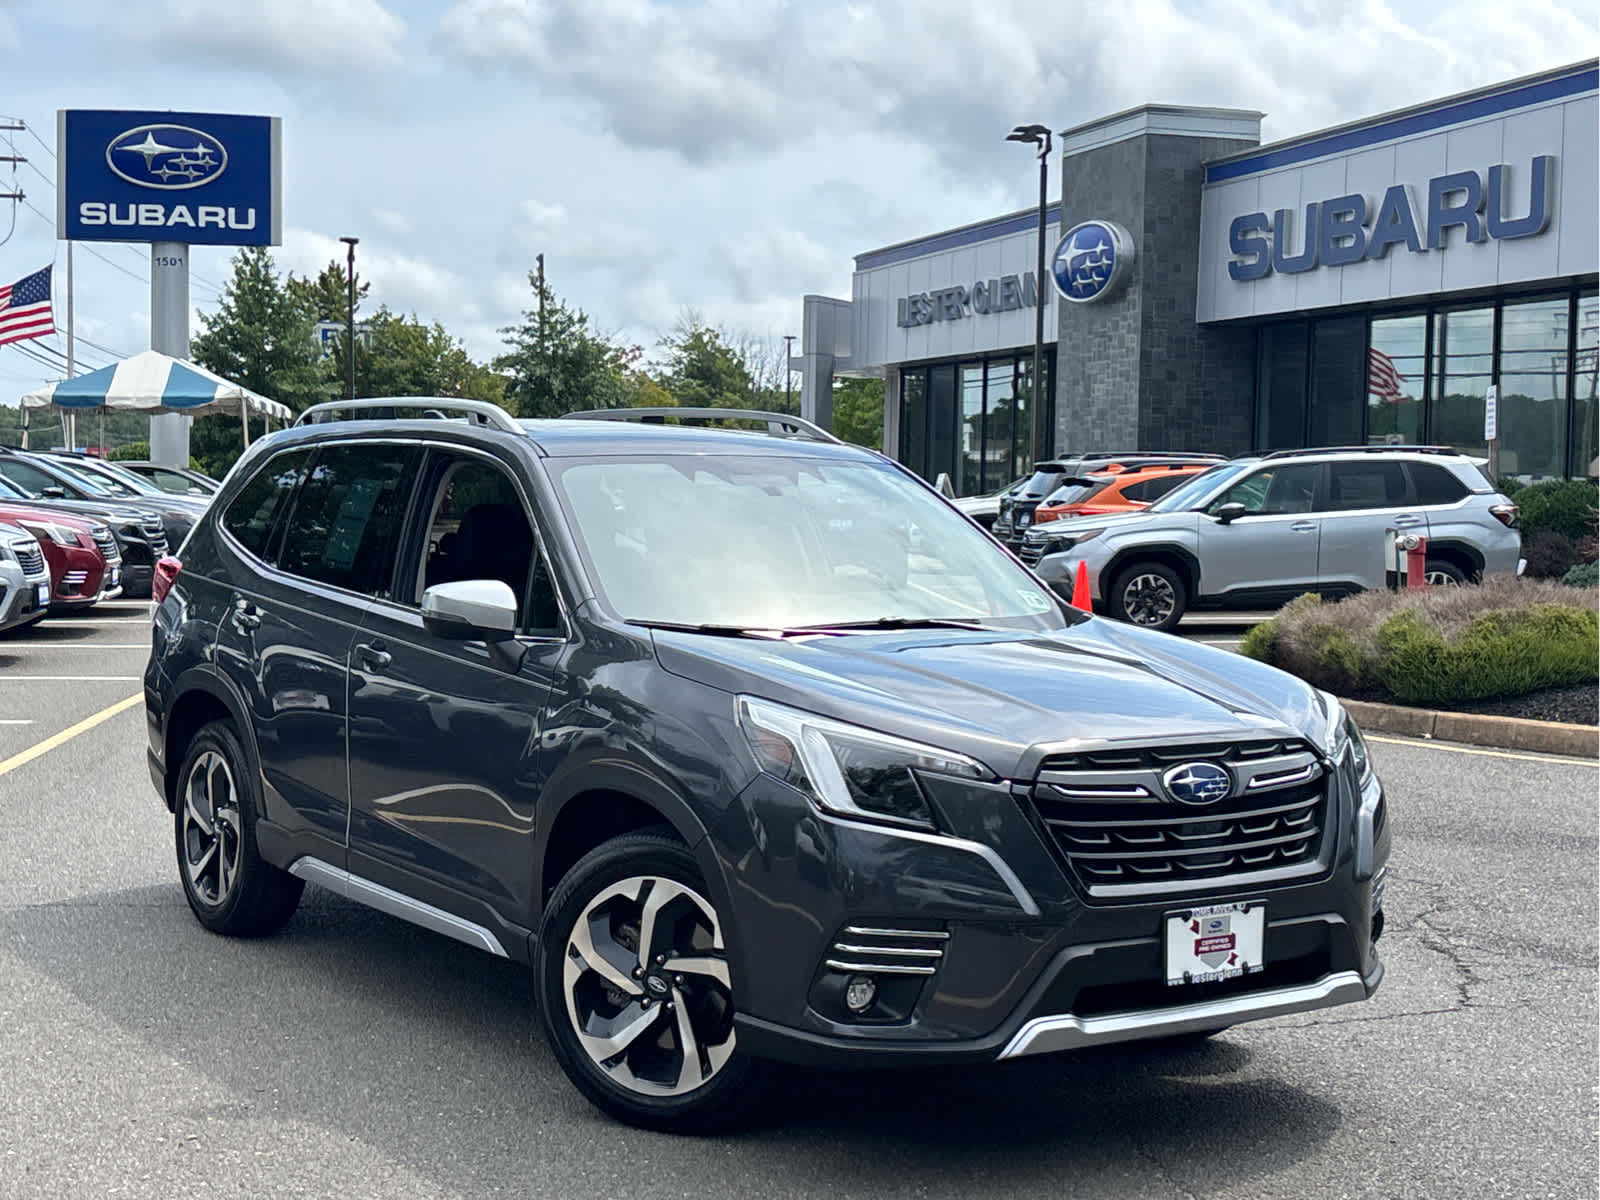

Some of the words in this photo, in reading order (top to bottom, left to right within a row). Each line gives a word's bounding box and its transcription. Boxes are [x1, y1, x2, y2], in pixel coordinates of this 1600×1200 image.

[79, 201, 256, 230] SUBARU
[1228, 155, 1554, 281] SUBARU
[155, 256, 183, 267] 1501
[897, 285, 971, 328] LESTER
[973, 270, 1050, 315] GLENN
